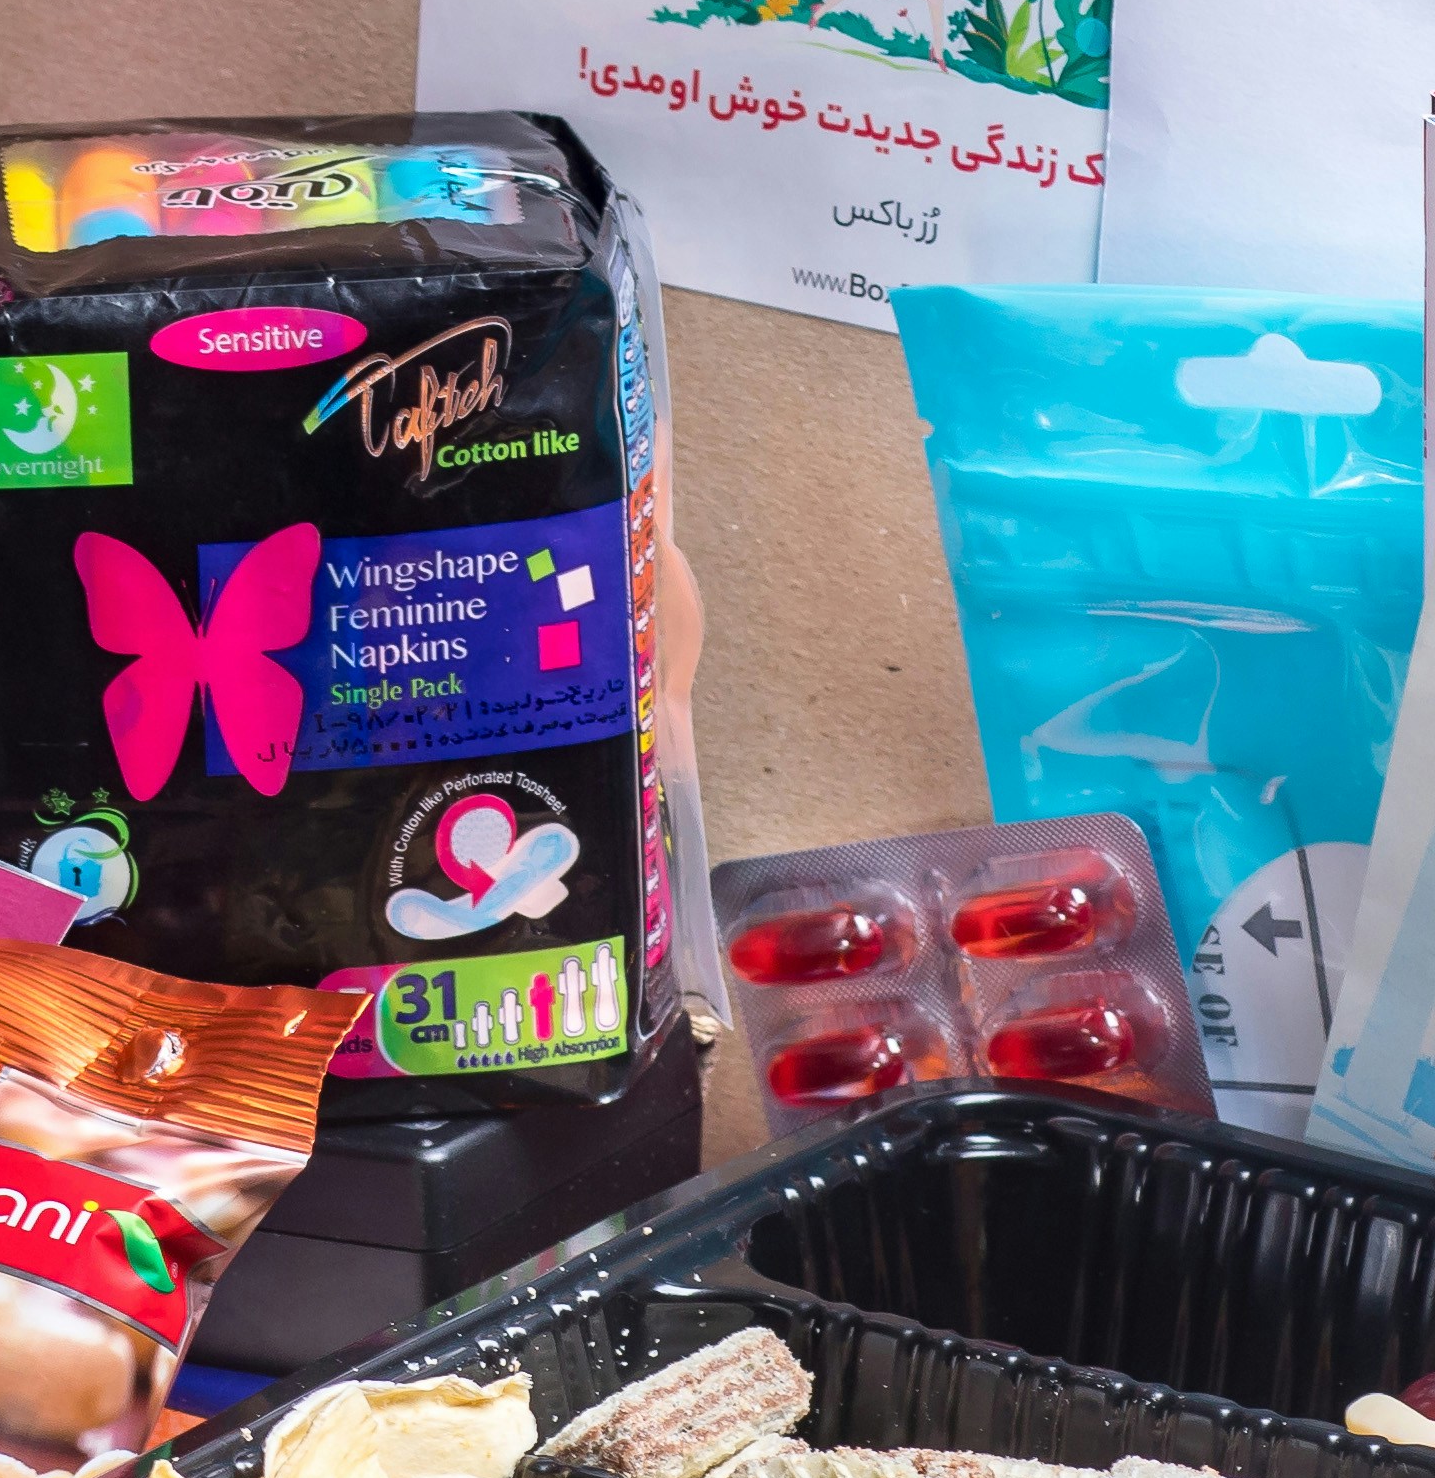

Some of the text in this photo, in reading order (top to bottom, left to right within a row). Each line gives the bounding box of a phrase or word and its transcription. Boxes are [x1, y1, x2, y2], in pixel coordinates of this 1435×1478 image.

[578, 47, 701, 111] اومدی!
[708, 75, 807, 130] خوش
[818, 103, 942, 163] جدیدت
[950, 123, 1059, 189] زندگی
[197, 324, 324, 354] Sensitive
[437, 429, 580, 468] Cotton like
[326, 549, 519, 592] Wingshape
[331, 592, 487, 632] Feminine
[331, 632, 468, 674] Napkins
[331, 671, 464, 710] Single Pack
[389, 770, 569, 888] With Cotton like Perforated Topsheet
[395, 970, 458, 1025] 31
[410, 1022, 450, 1045] cm
[517, 1033, 621, 1064] High Absorption
